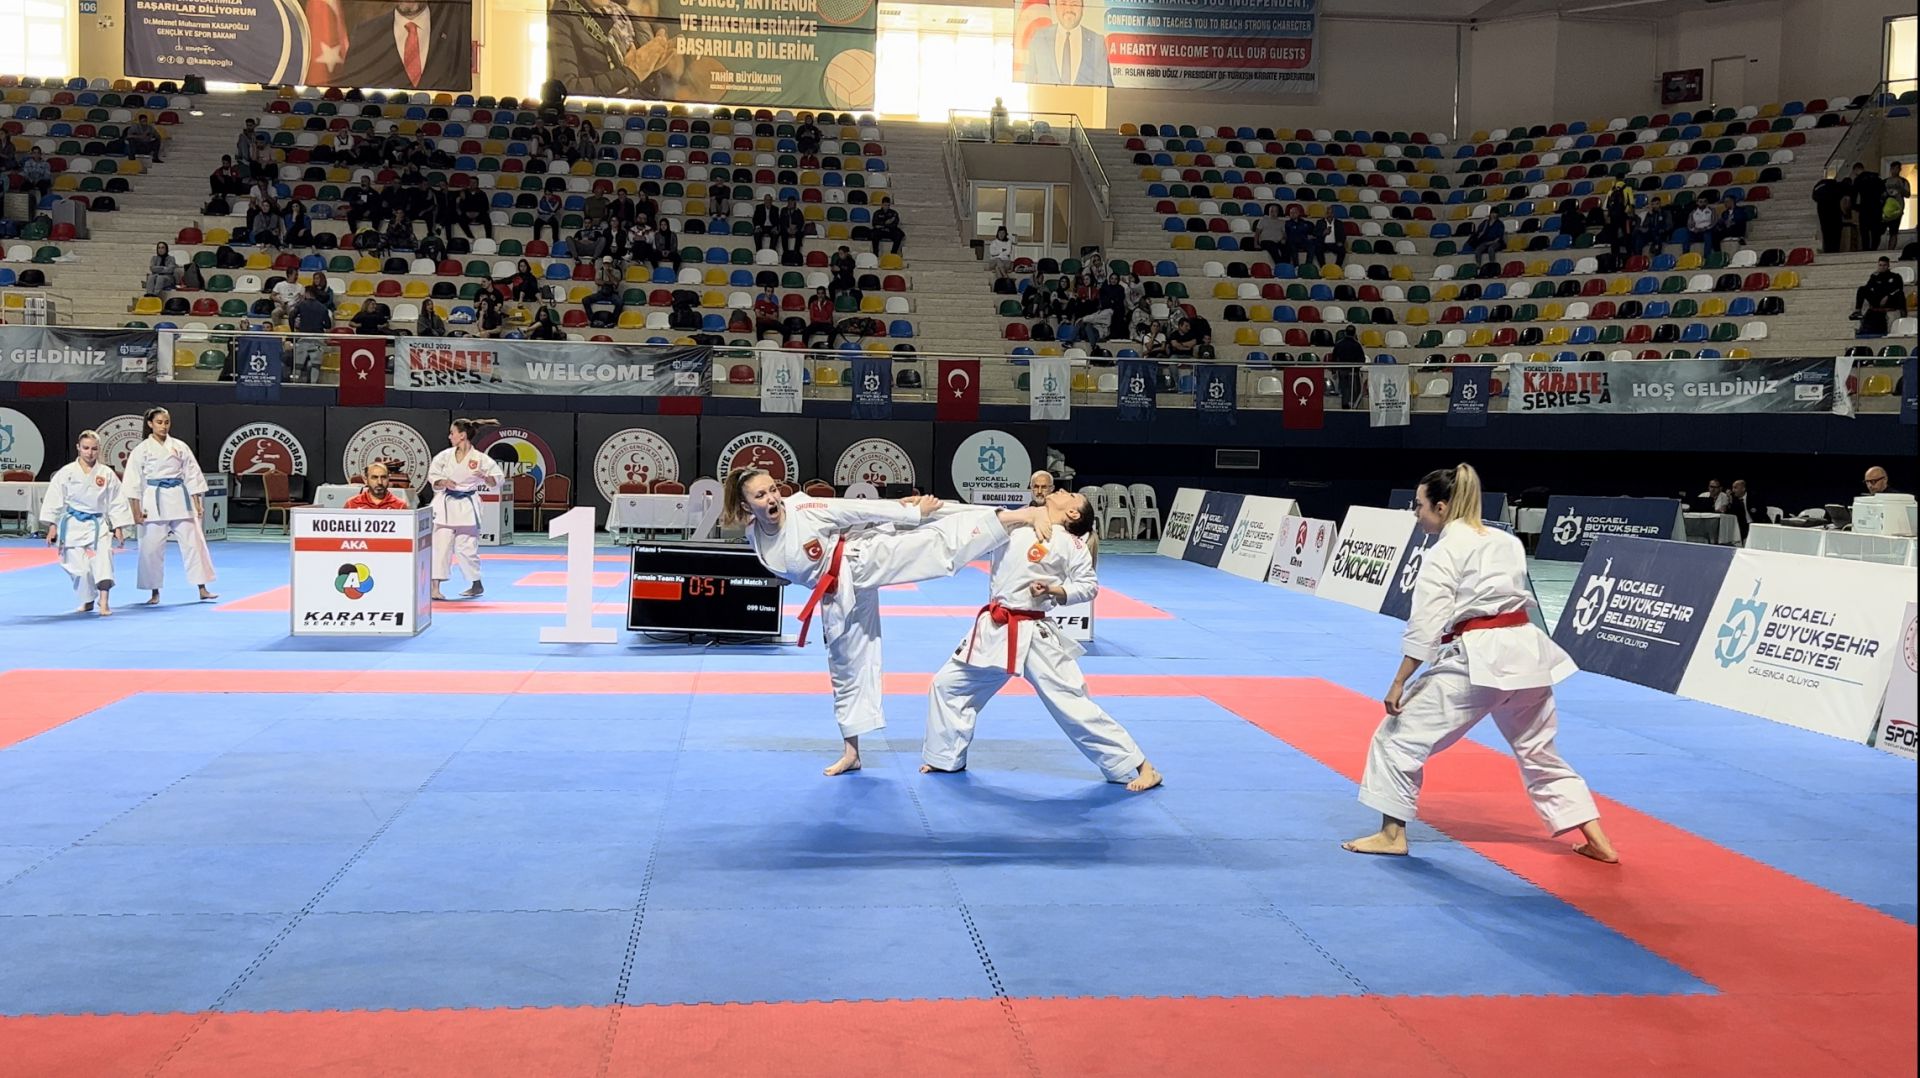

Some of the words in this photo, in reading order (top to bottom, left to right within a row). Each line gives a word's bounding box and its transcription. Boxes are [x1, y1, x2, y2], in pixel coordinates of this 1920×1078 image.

[80, 2, 97, 12] 106
[137, 1, 196, 12] BAŞARILAR
[198, 4, 257, 16] DİLİYORUM
[680, 13, 698, 32] VE
[701, 14, 818, 37] HAKEMLERİMİZE
[1107, 14, 1145, 26] CONFIDENT
[1146, 17, 1160, 27] AND
[1162, 17, 1192, 28] TEACHES
[1194, 18, 1208, 29] YOU
[1210, 19, 1219, 29] TO
[1220, 19, 1243, 29] REACH
[676, 37, 754, 60] BAŞARILAR
[757, 39, 819, 61] DİLERİM.
[1109, 42, 1117, 54] A
[1120, 43, 1157, 57] HEARTY
[1160, 44, 1209, 58] WELCOME
[1212, 46, 1224, 58] TO
[1226, 46, 1244, 58] ALL
[1247, 46, 1267, 59] OUR
[1269, 47, 1306, 60] GUESTS
[710, 70, 734, 83] TAHİR
[735, 71, 782, 84] BÜYÜKAKIN
[10, 345, 106, 365] GELDİNİZ
[526, 360, 655, 382] WELCOME
[1632, 382, 1676, 401] HOŞ
[1683, 376, 1779, 397] GELDİNİZ
[1522, 390, 1591, 411] SERIES
[1598, 388, 1612, 404] A
[499, 429, 528, 439] WORLD
[230, 427, 268, 448] KARATE
[272, 430, 303, 474] FEDERASY
[727, 435, 763, 455] KARATE
[766, 437, 796, 480] FEDERASY
[982, 493, 1007, 501] KOCAELİ
[1007, 494, 1023, 502] 2022
[312, 517, 361, 532] KOCAELİ
[364, 520, 396, 533] 2022
[340, 540, 368, 549] AKA
[1351, 540, 1373, 557] SPOR
[1371, 543, 1397, 561] KENTİ
[1341, 556, 1391, 586] KOCAELİ
[689, 576, 725, 596] 0:51
[1616, 578, 1665, 598] KOCAELİ
[1609, 593, 1694, 622] BÜYÜKŞEHİR
[1771, 603, 1837, 627] KOCAELİ
[1603, 610, 1666, 634] BELEDİYESİ
[1763, 622, 1880, 658] BÜYÜKŞEHİR
[1756, 642, 1842, 671] BELEDİYESİ
